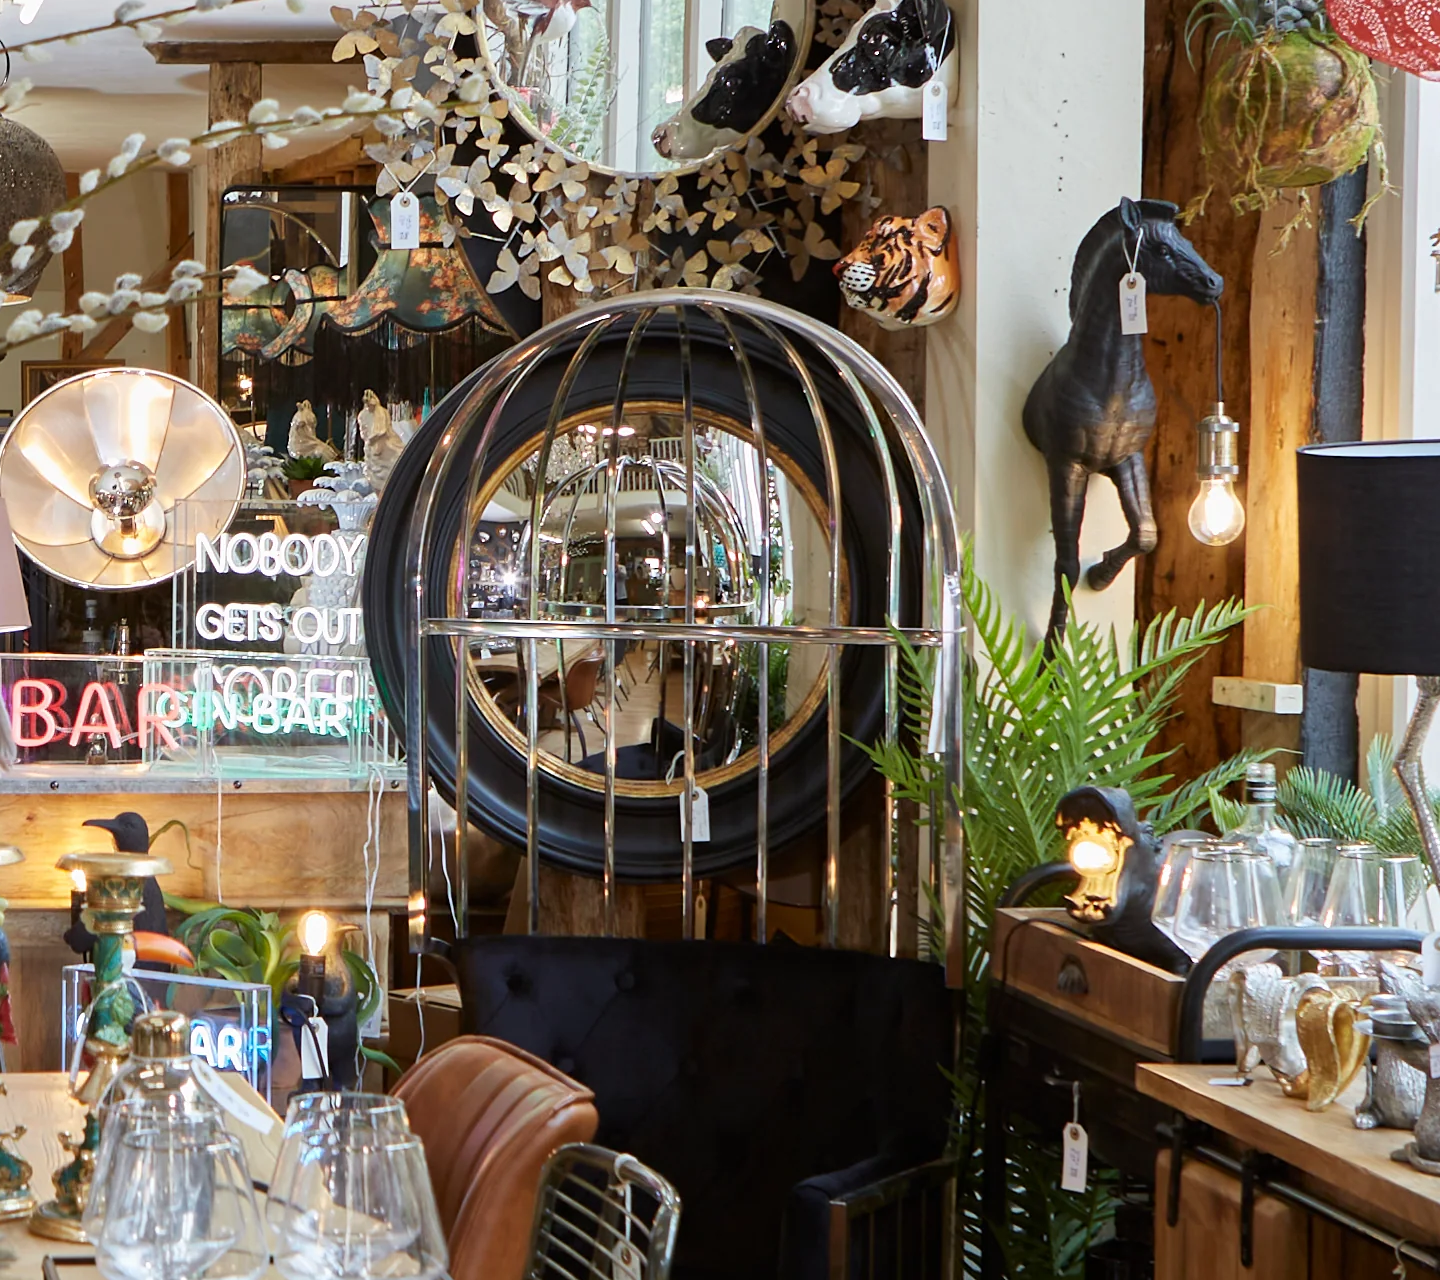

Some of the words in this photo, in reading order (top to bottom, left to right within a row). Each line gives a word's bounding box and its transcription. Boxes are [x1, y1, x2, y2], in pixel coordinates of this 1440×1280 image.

[195, 532, 368, 577] NOBODY
[195, 603, 284, 642] GETS
[291, 606, 363, 645] OUT
[11, 679, 180, 751] BAR
[156, 690, 238, 730] GIN
[252, 692, 349, 736] BAR
[190, 1023, 244, 1072] AR
